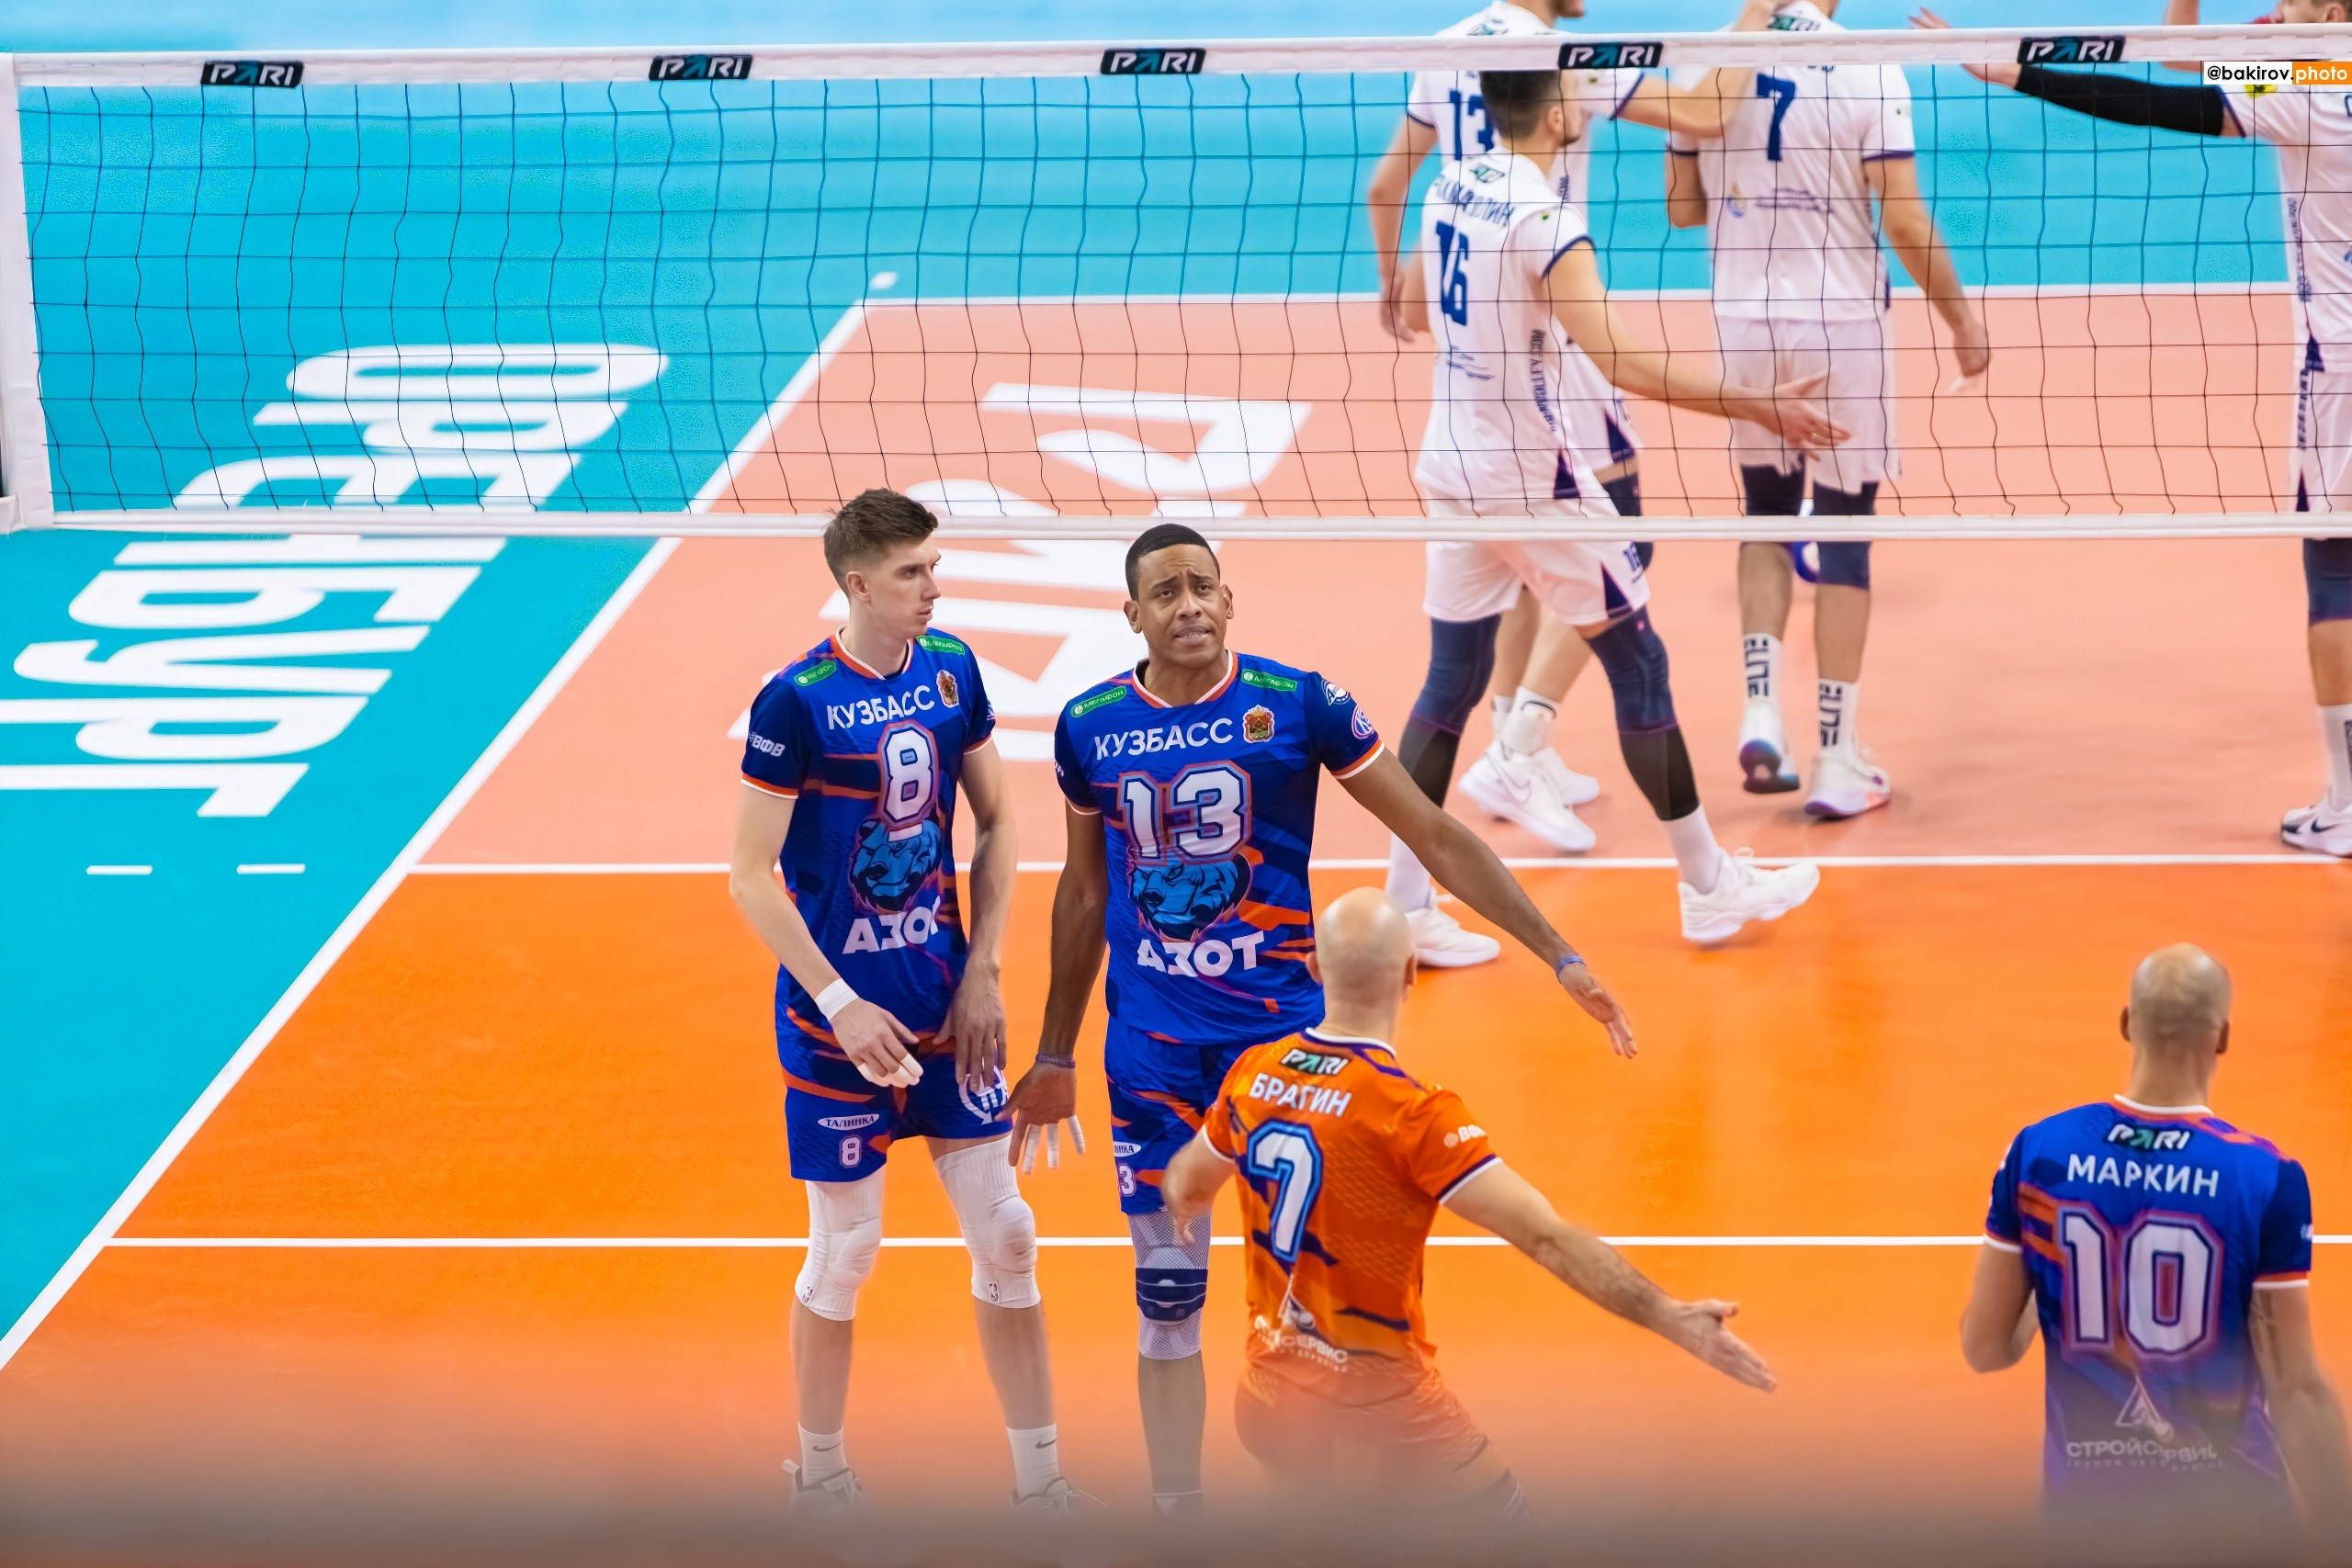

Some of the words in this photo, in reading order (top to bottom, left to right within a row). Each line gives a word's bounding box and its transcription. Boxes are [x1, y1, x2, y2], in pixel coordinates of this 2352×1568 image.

[659, 56, 743, 78] PARI
[1110, 51, 1196, 73] PARI
[1567, 45, 1654, 67] PARI
[2026, 40, 2115, 62] PARI
[209, 63, 294, 85] PARI
[1756, 72, 1796, 162] 7
[1435, 220, 1470, 326] 16
[827, 685, 934, 729] КУЗБАСС
[1094, 717, 1234, 761] КУЗБАСС
[879, 721, 937, 829] 8
[1120, 762, 1250, 863] 13
[1281, 1048, 1350, 1076] PARI
[1249, 1073, 1352, 1118] БРАГИН
[825, 1115, 875, 1128] ТАЛИНКА
[2108, 1124, 2190, 1150] PARI
[841, 1134, 862, 1168] 8
[2067, 1154, 2219, 1198] МАРКИН
[2061, 1207, 2216, 1360] 10
